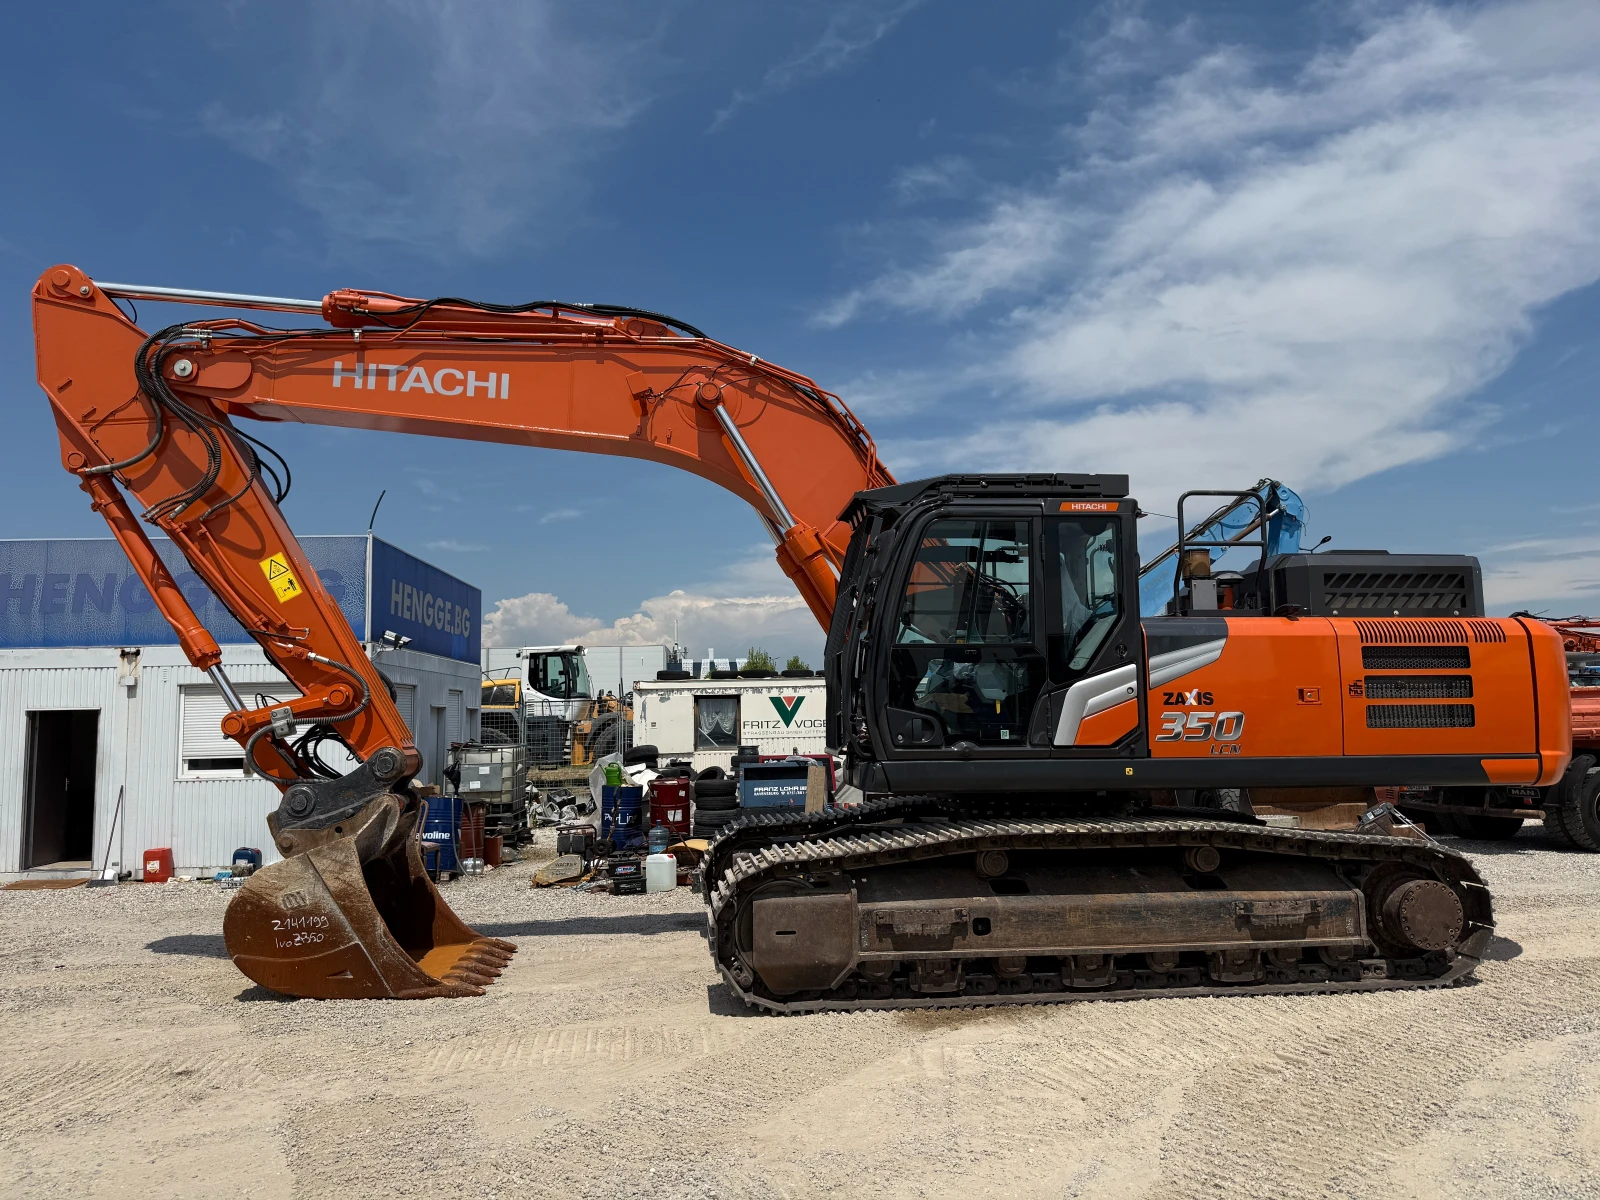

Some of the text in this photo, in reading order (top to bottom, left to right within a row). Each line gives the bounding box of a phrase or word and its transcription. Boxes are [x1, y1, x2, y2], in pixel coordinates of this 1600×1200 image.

[332, 360, 510, 400] HITACHI
[390, 578, 471, 638] HENGGE.BG
[1162, 688, 1214, 706] ZAXIS
[743, 720, 781, 729] FRITZ
[1155, 711, 1245, 742] 350
[1209, 743, 1242, 755] LCN
[1511, 788, 1536, 796] MAN
[271, 915, 329, 931] 2141199
